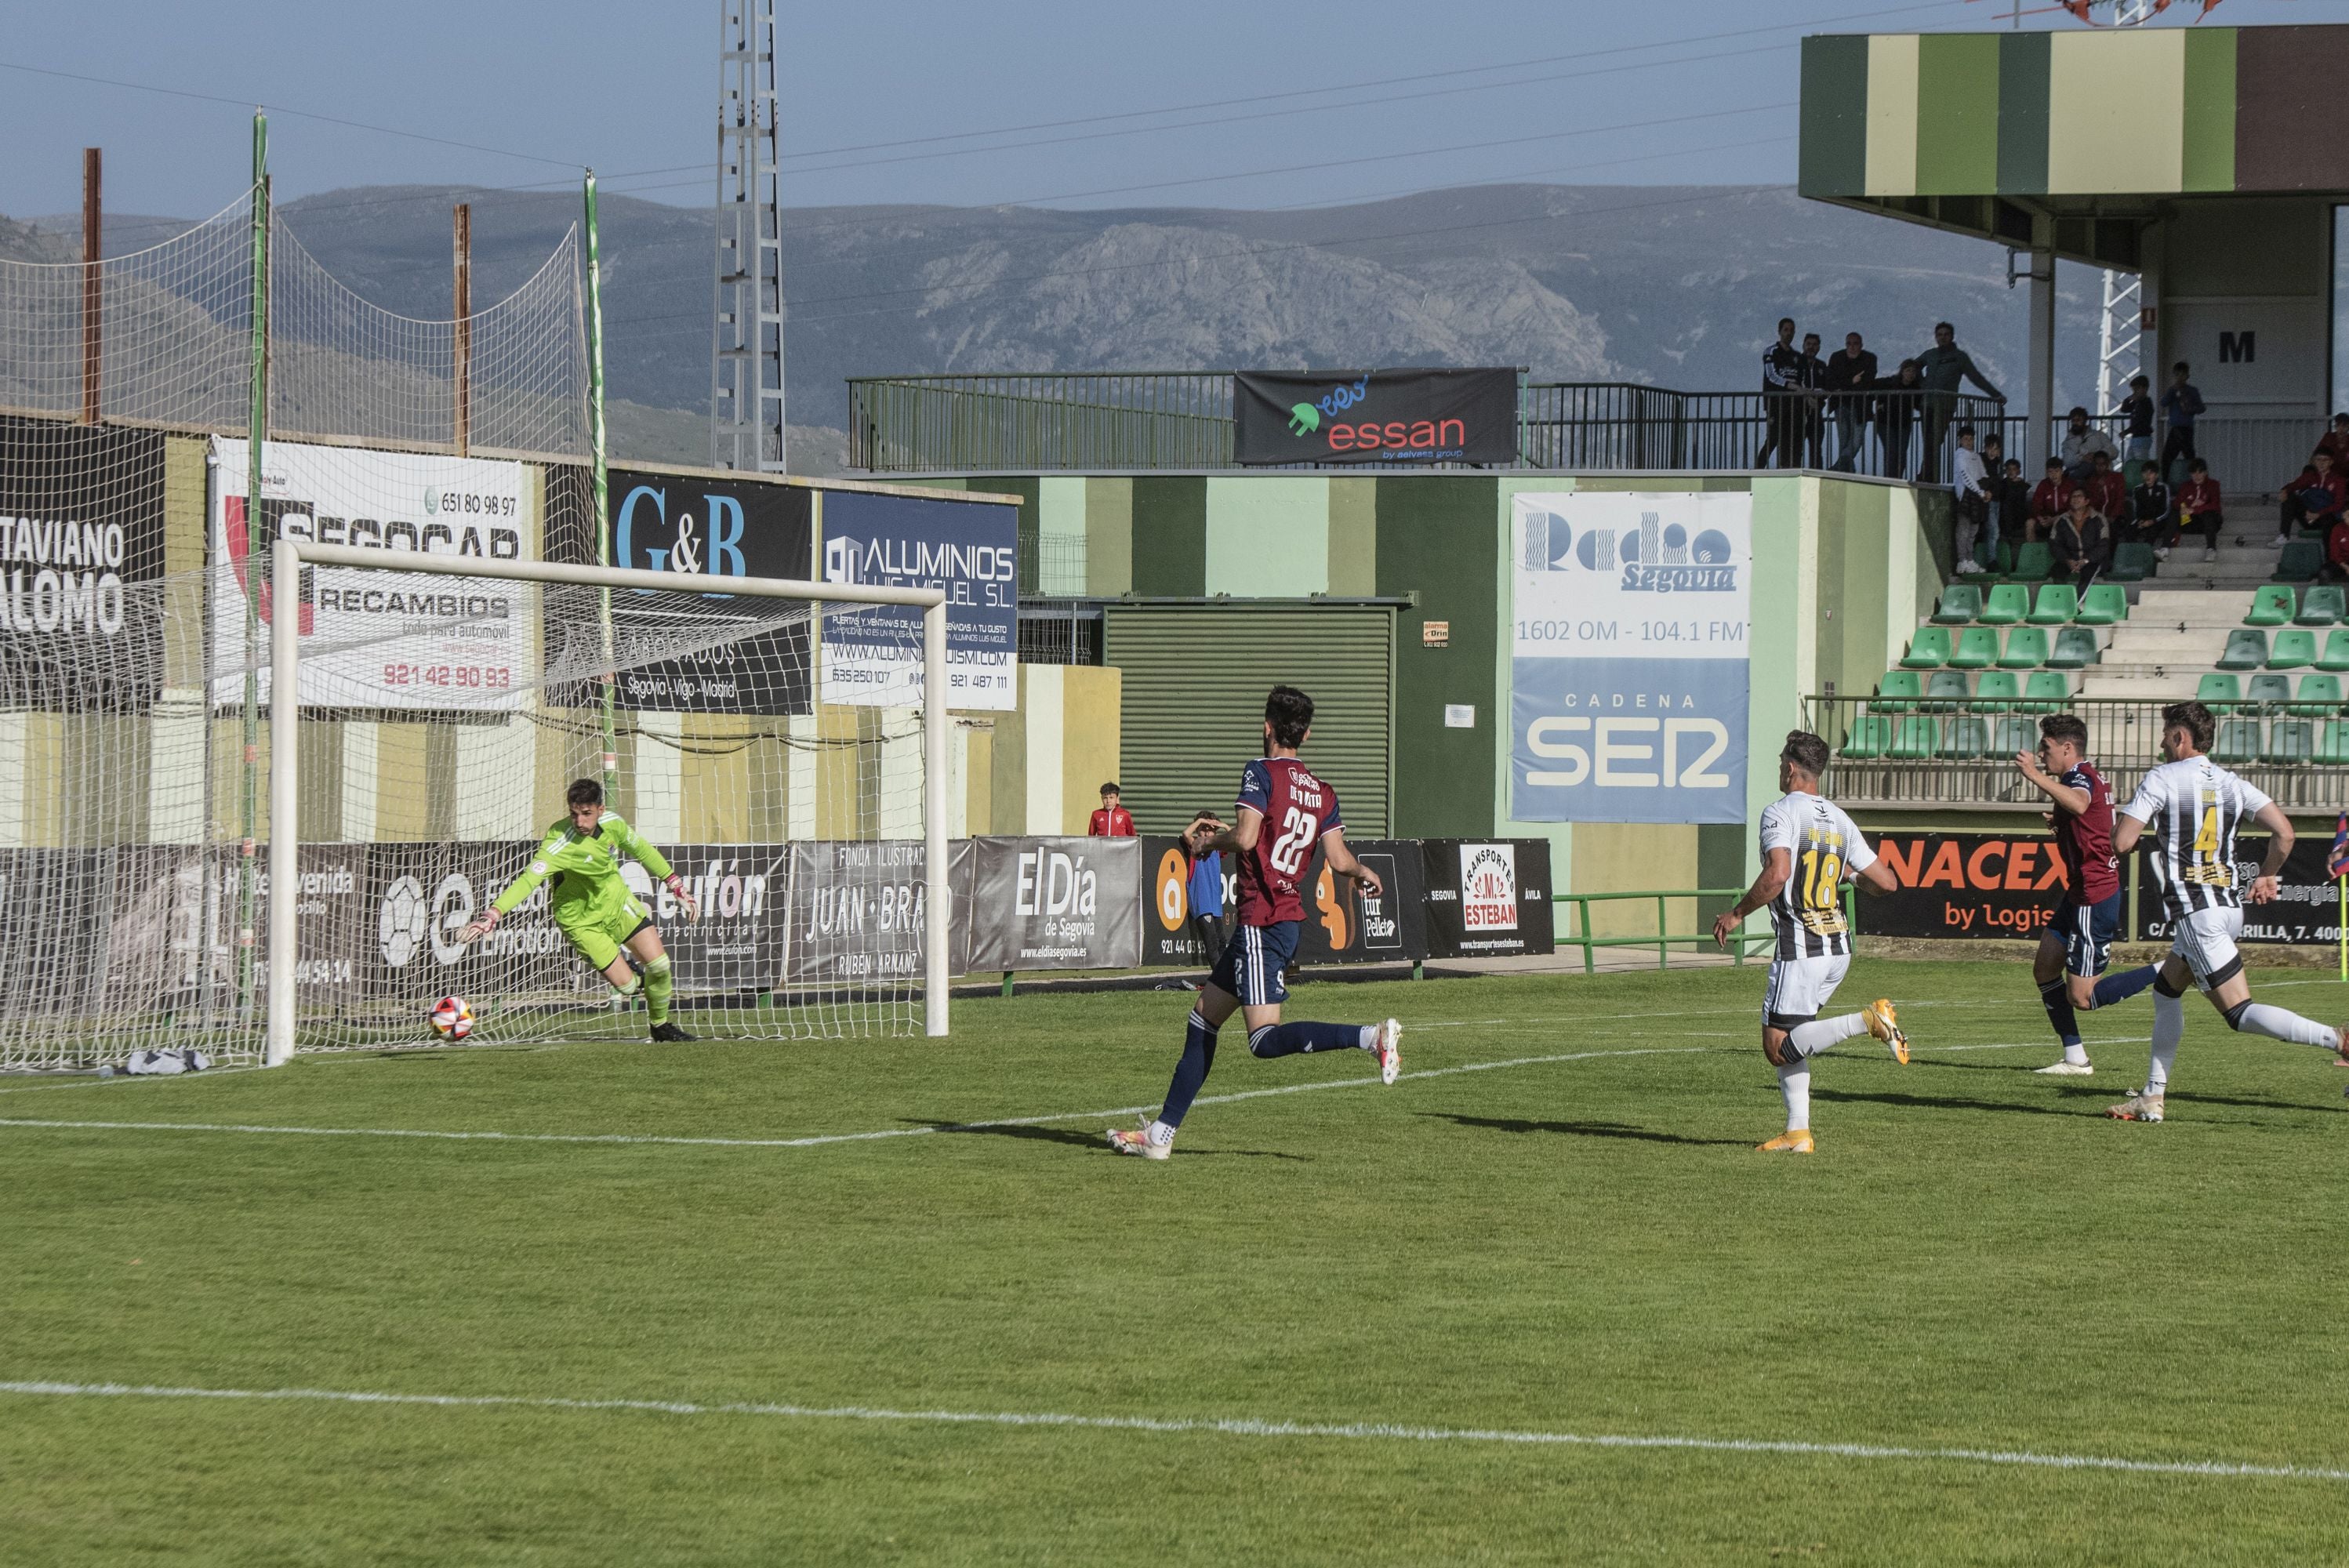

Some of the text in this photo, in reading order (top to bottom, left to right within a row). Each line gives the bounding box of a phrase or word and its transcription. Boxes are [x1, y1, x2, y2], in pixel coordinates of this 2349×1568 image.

[2219, 331, 2256, 363] M
[1328, 419, 1465, 450] essan
[1382, 451, 1395, 459] by
[1436, 450, 1463, 459] group
[442, 492, 517, 516] 651 80 98 97
[1525, 511, 1731, 572] Radio
[864, 537, 1014, 582] ALUMINIOS
[1621, 561, 1737, 593] Segovia
[320, 587, 509, 619] RECAMBIOS
[985, 583, 1014, 608] S.L.
[832, 615, 859, 626] PUERTAS
[861, 617, 866, 626] Y
[866, 618, 899, 628] VENTANAS
[899, 619, 909, 628] DE
[972, 623, 978, 633] A
[978, 624, 987, 633] TU
[987, 625, 1007, 634] GUSTO
[1517, 620, 1570, 641] 1602
[1578, 621, 1617, 641] OM
[1641, 621, 1701, 641] 104.1
[1709, 621, 1743, 641] FM
[383, 664, 510, 688] 921 42 90 93
[628, 675, 666, 699] Segovia
[673, 678, 695, 701] Vigo
[703, 680, 735, 699] Madrid
[832, 668, 1007, 688] 635 250 107 921 487 111
[1565, 693, 1695, 709] CADENA
[1526, 716, 1730, 788] SER
[1270, 806, 1317, 875] 22
[2193, 805, 2219, 863] 4
[839, 847, 870, 867] FONDA
[1877, 839, 2071, 891] NACEX
[1015, 846, 1097, 916] El Día
[1464, 848, 1515, 893] TRANSPORTES
[1802, 849, 1842, 909] 18
[1431, 889, 1458, 901] SEGOVIA
[1524, 887, 1541, 900] ÁVILA
[805, 885, 866, 943] JUAN
[1465, 903, 1517, 925] ESTEBAN
[1945, 902, 1976, 931] by
[658, 920, 759, 938] electricidad
[1044, 915, 1095, 942] de Segovia
[1365, 916, 1387, 937] Pellet
[2149, 922, 2166, 937] C/
[1020, 944, 1087, 960] www.eldiasegovia.es
[1160, 939, 1174, 954] 921
[1175, 939, 1185, 954] 44
[1460, 938, 1525, 951] www.transportesesteban.es
[877, 952, 918, 974] ARNANZ
